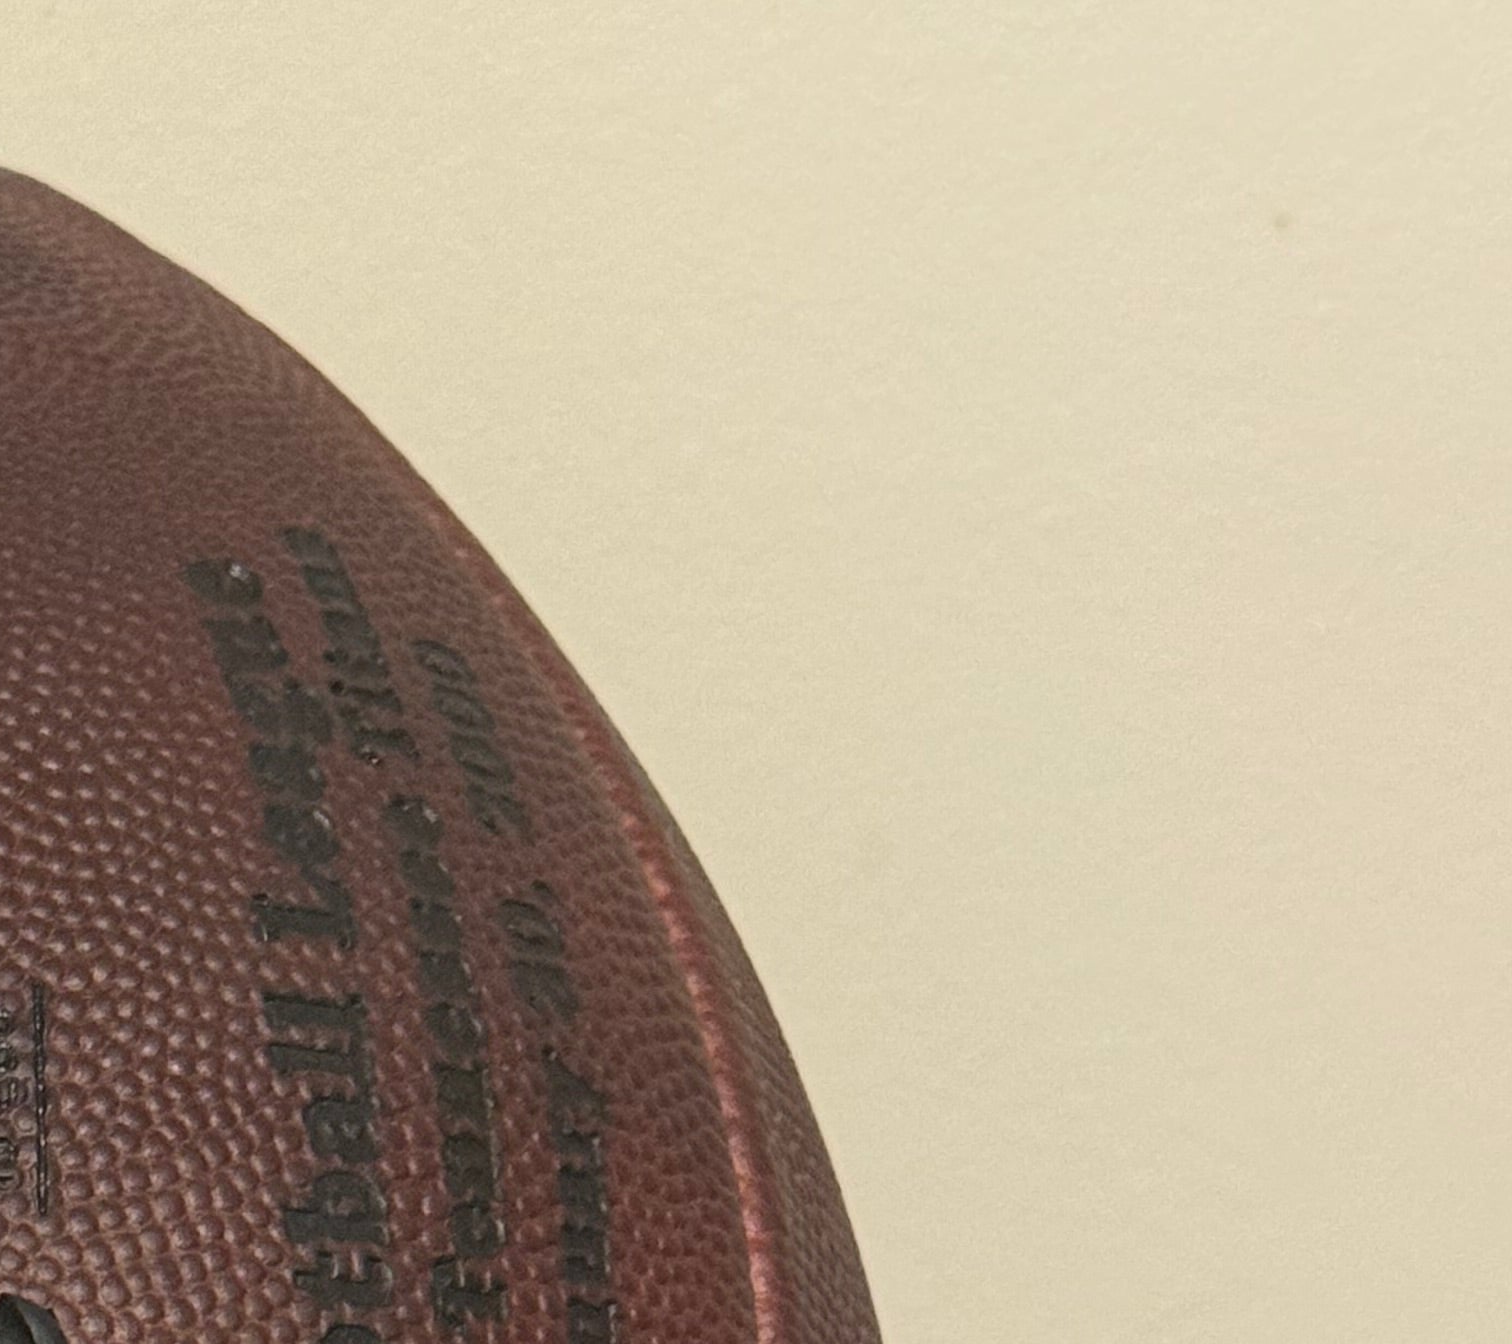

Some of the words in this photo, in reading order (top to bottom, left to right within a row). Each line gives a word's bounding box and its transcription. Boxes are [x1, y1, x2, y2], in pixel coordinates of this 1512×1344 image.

[181, 558, 356, 951] League
[278, 525, 420, 766] Titans
[410, 638, 536, 846] 2000
[388, 794, 506, 1332] Tennessee
